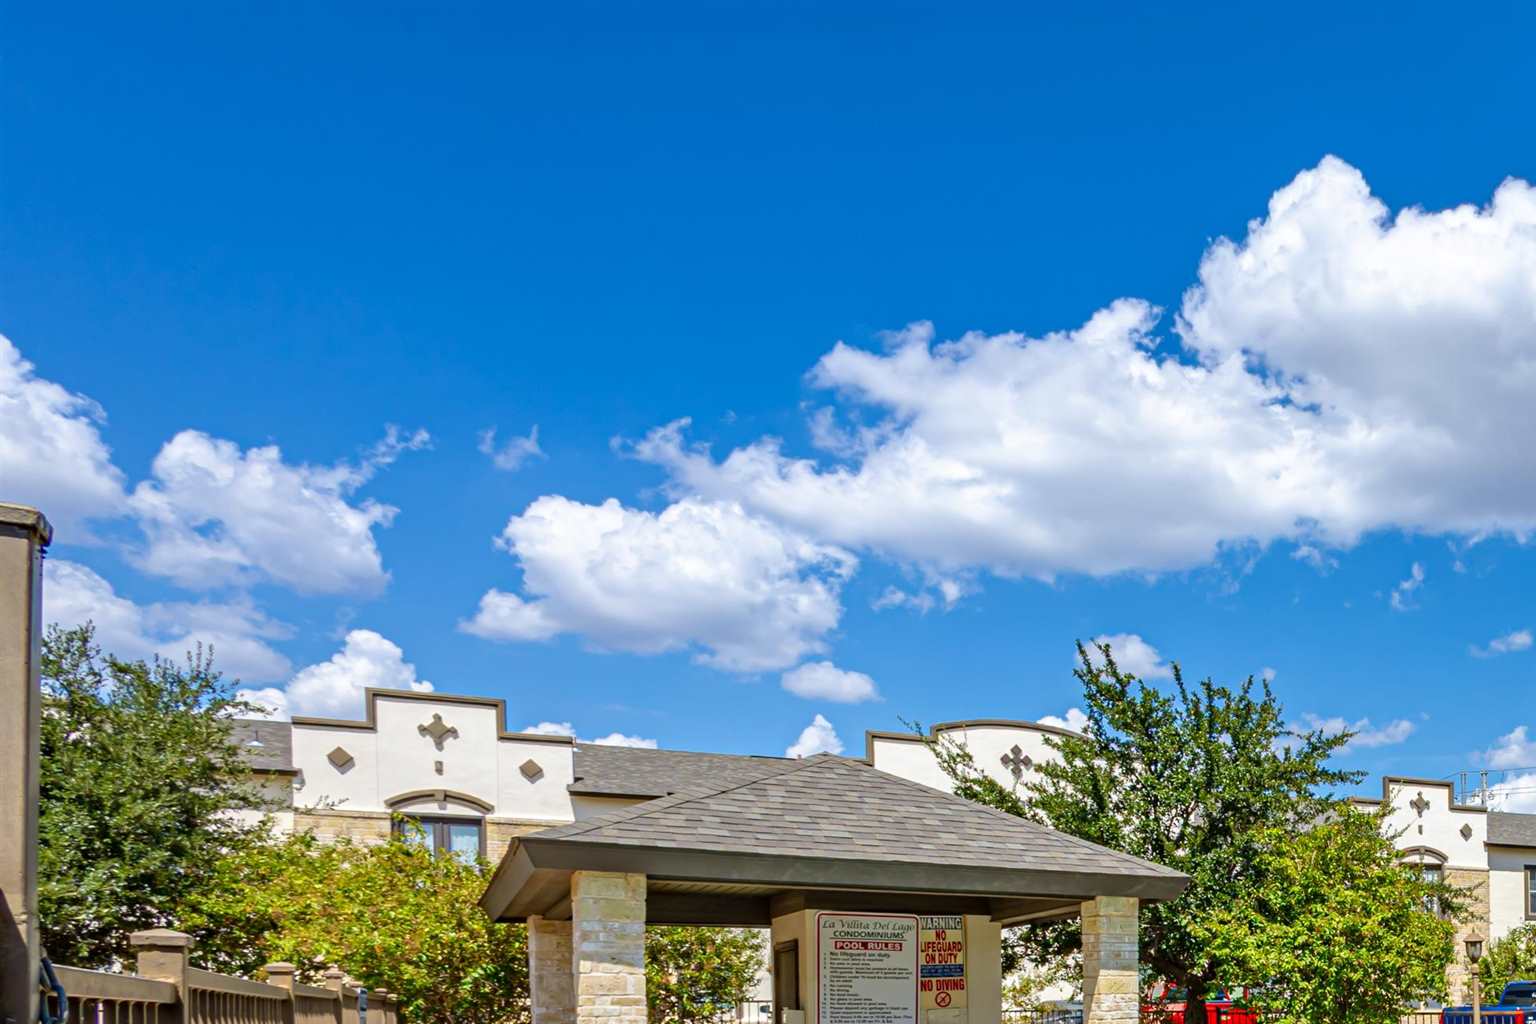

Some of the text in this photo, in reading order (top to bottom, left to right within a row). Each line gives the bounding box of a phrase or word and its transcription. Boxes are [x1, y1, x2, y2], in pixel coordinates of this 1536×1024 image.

[822, 919, 836, 929] La
[873, 921, 890, 931] Del
[920, 917, 962, 929] WARNING
[833, 930, 905, 939] CONDOMINIUMS
[935, 930, 947, 941] NO
[836, 941, 901, 951] POOL RULES
[920, 941, 963, 952] LIFEGUARD
[925, 953, 958, 964] ON DUTY
[920, 979, 965, 992] NO DIVING
